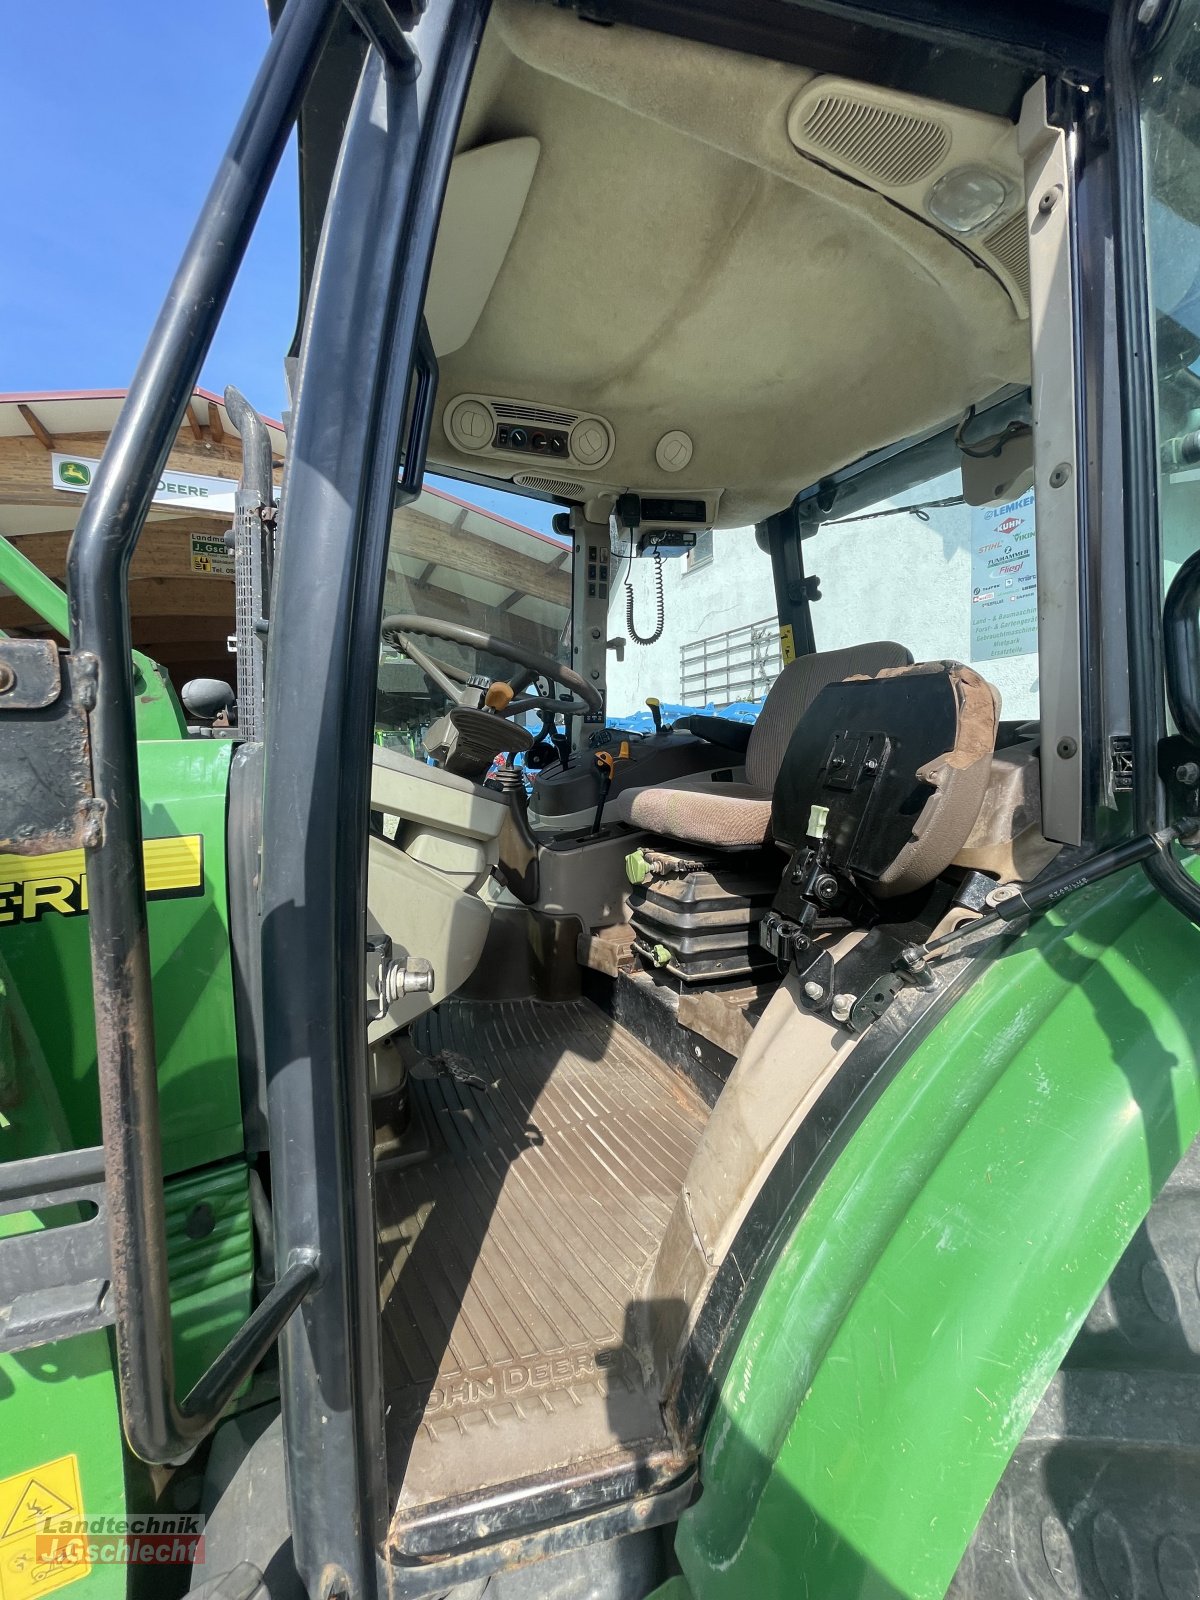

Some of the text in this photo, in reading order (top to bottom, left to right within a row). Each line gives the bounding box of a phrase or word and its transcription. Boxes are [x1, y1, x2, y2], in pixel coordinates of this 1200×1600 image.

[997, 518, 1022, 532] KUHN
[978, 542, 1003, 554] STIHL
[1000, 562, 1024, 575] Fliegl
[422, 1350, 616, 1414] OHN DEERE
